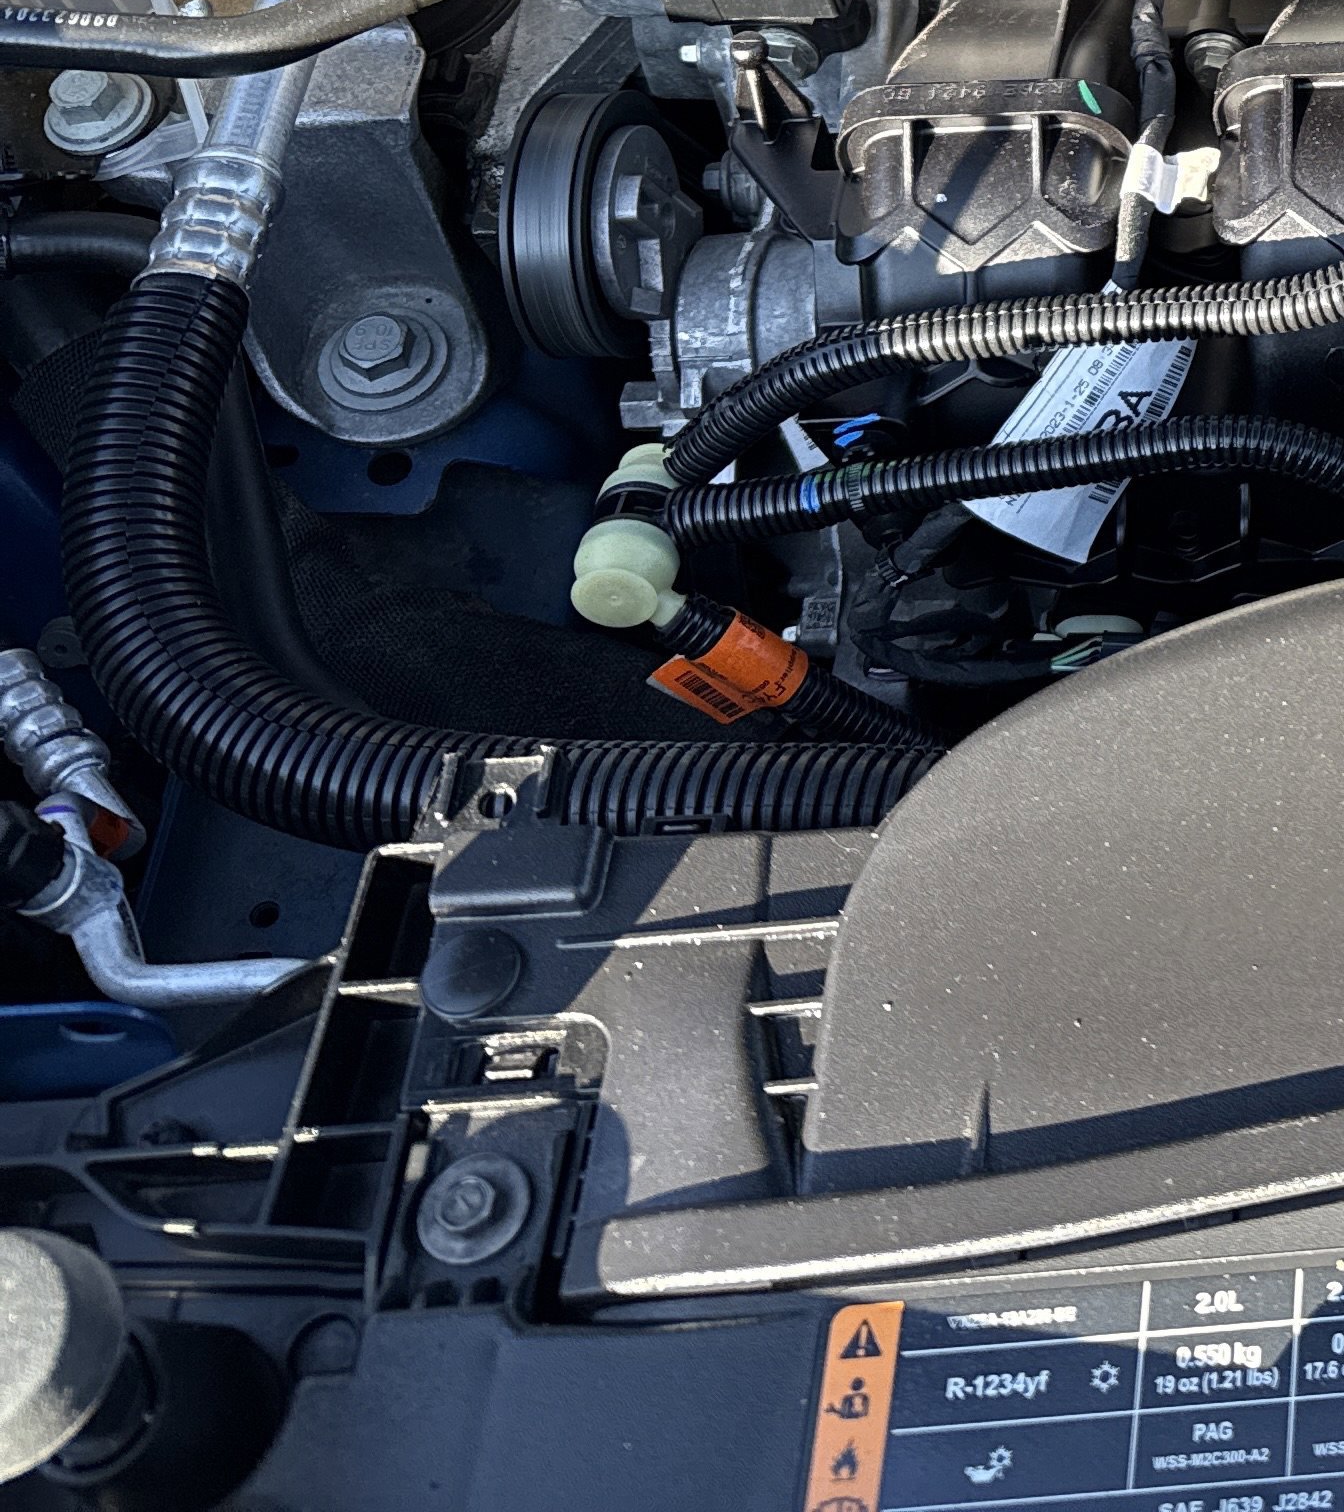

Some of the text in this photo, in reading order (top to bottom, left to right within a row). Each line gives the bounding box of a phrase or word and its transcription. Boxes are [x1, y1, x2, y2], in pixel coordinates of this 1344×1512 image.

[1194, 1290, 1244, 1314] 2.0L
[1175, 1342, 1262, 1369] 0.550 kg
[1154, 1367, 1279, 1394] 19 oz (1.21 lbs)
[1304, 1360, 1339, 1381] 17.6
[945, 1370, 1051, 1400] R-1234yf
[1192, 1421, 1233, 1442] PAG
[1212, 1495, 1263, 1512] J639
[1272, 1490, 1332, 1511] J2842
